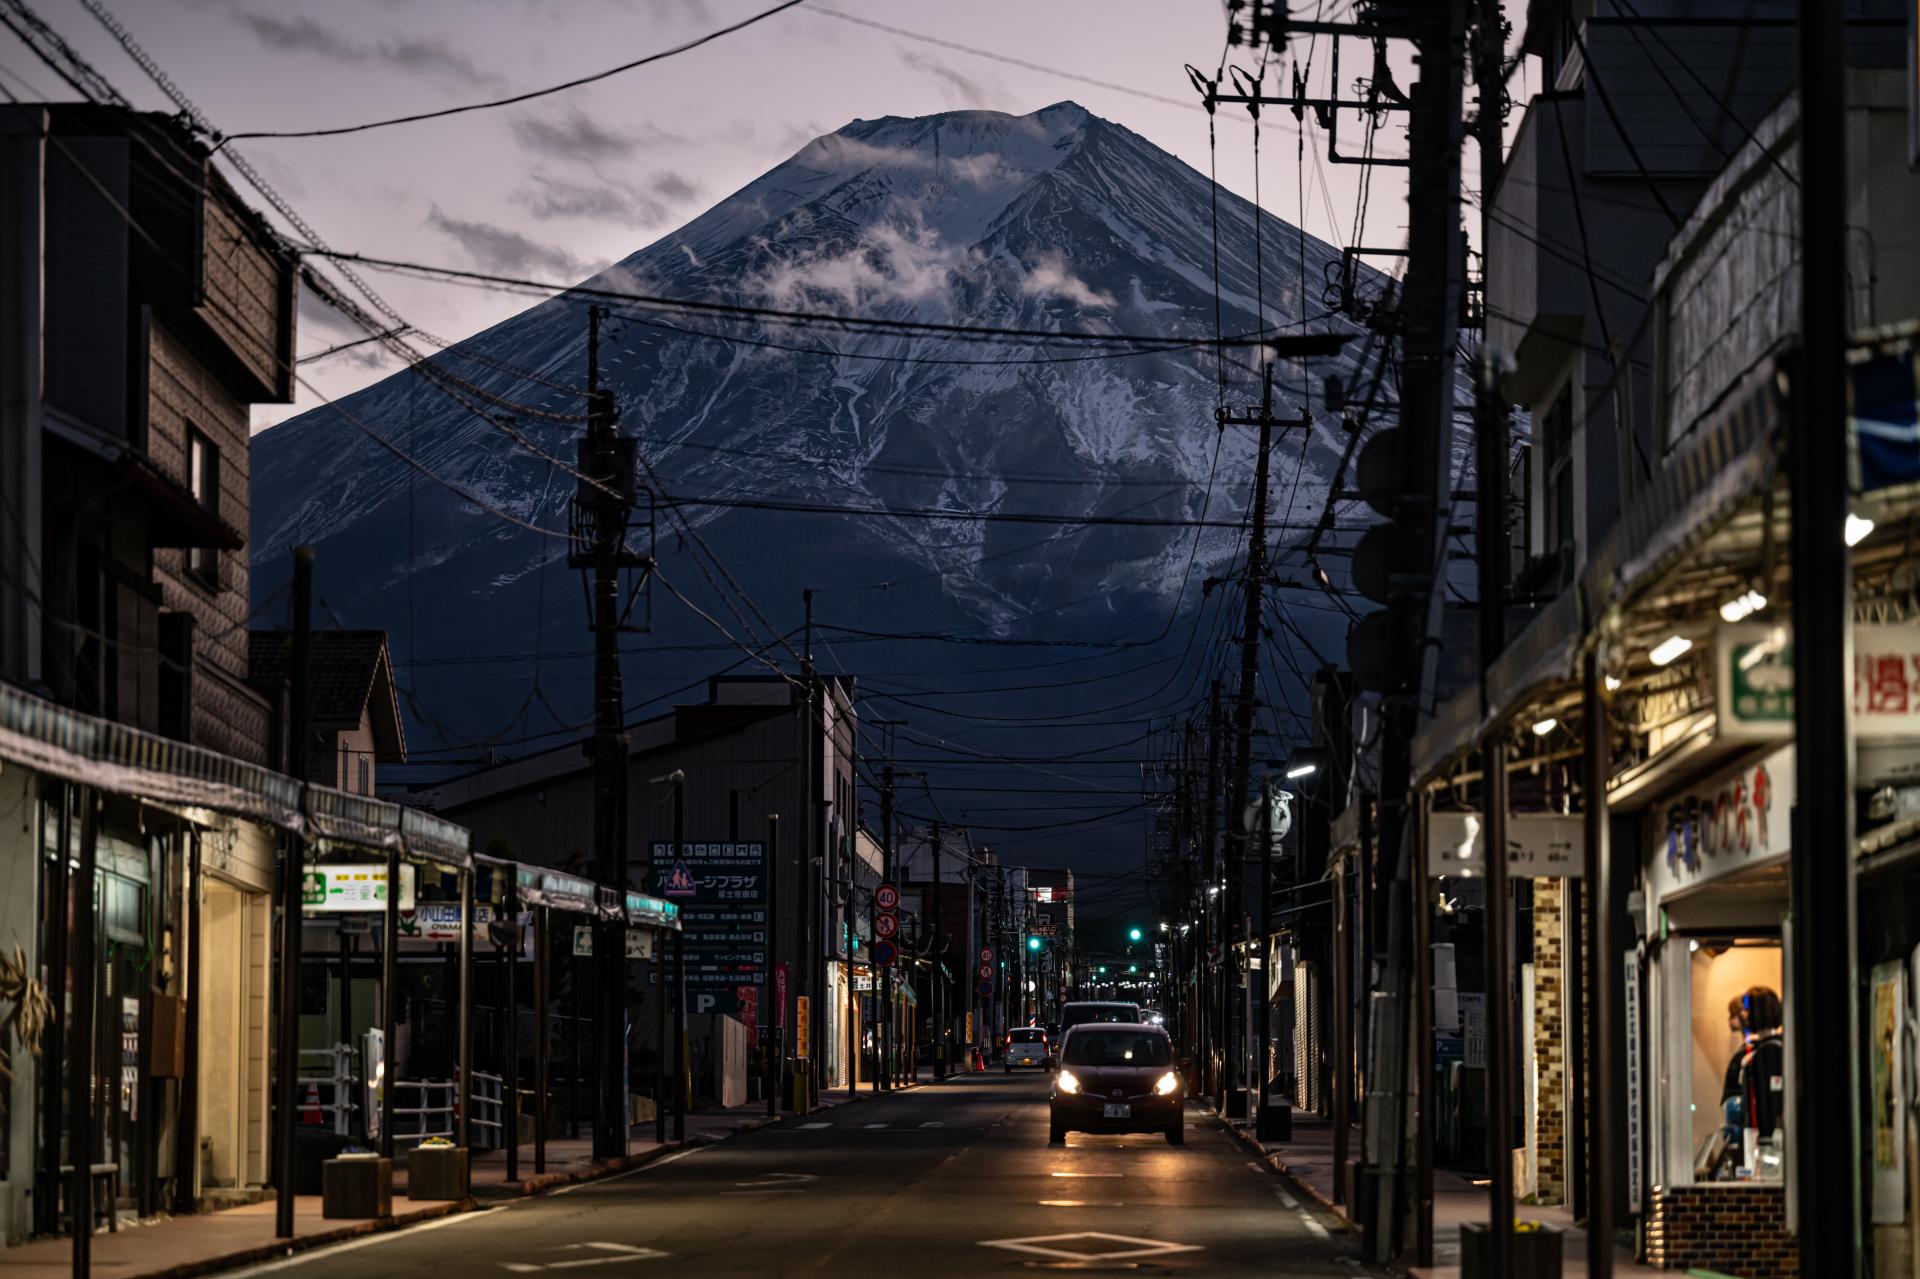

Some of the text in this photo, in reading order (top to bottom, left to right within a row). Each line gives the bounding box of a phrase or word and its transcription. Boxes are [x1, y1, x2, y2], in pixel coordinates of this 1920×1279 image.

[656, 874, 759, 888] ージプラザ
[880, 892, 893, 903] 40
[983, 952, 991, 960] 40
[697, 994, 716, 1013] P
